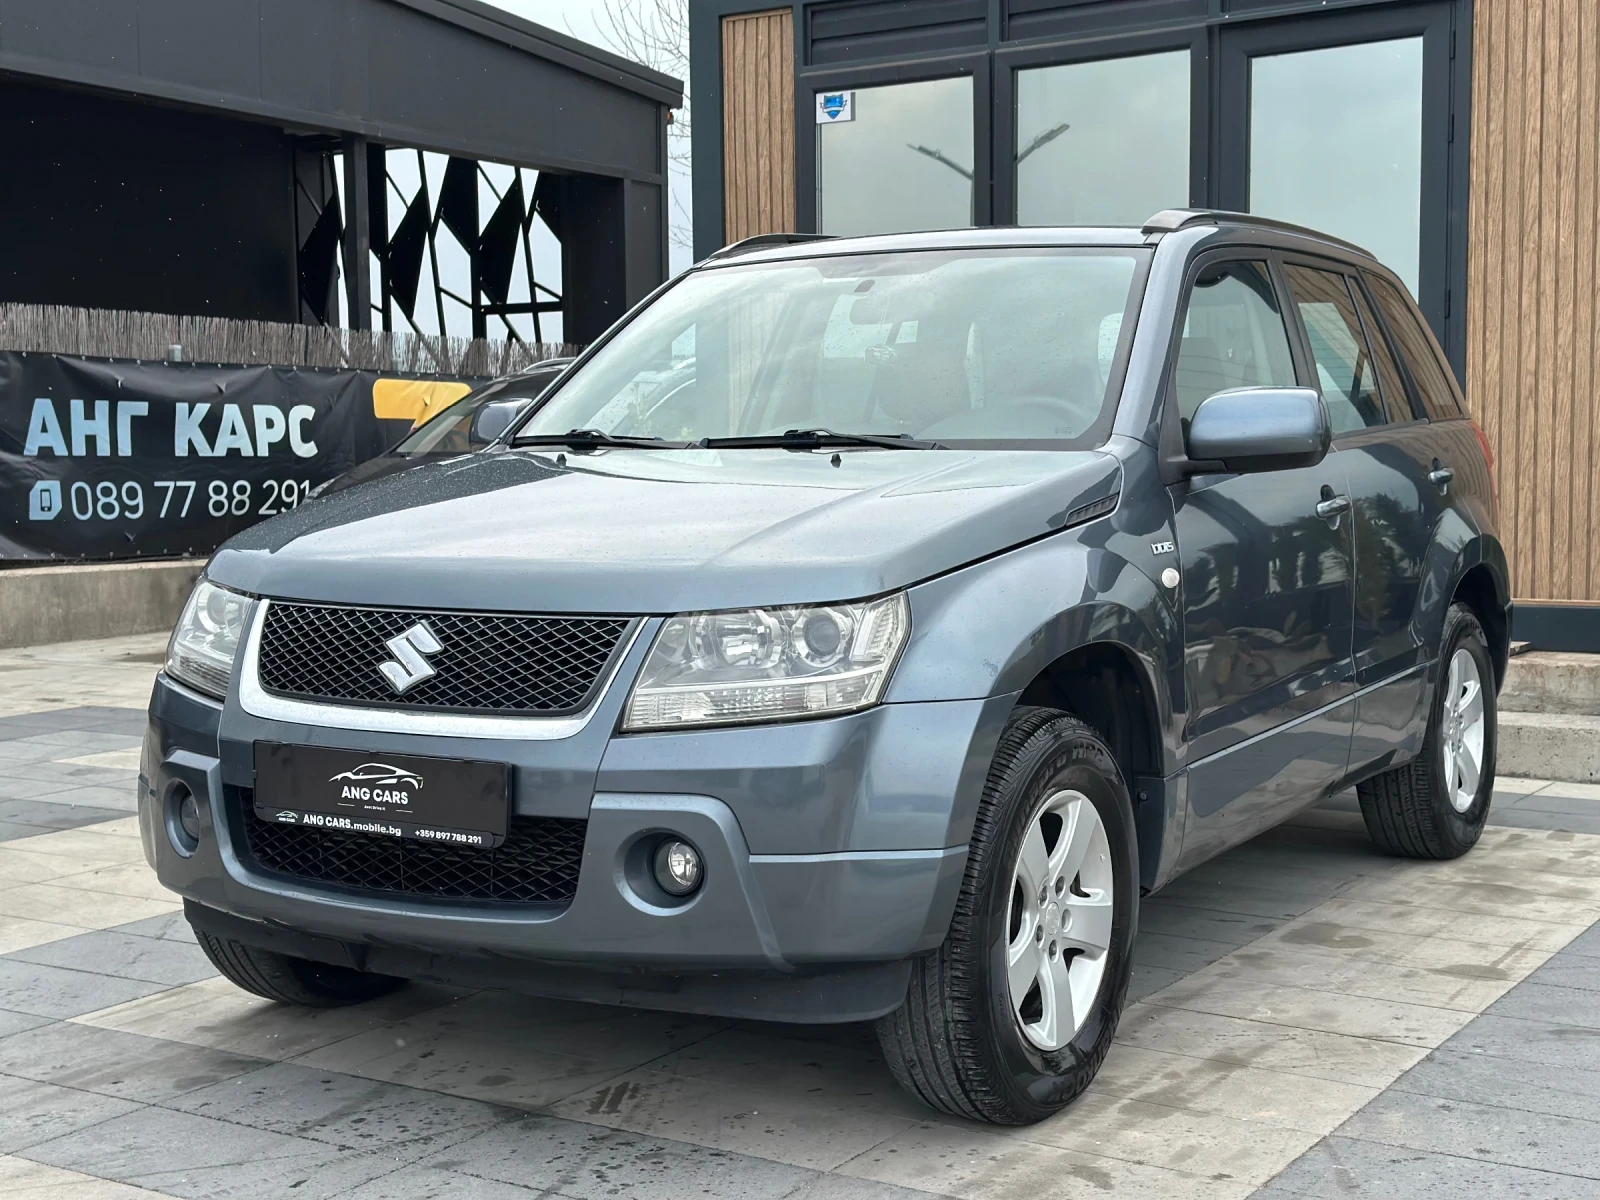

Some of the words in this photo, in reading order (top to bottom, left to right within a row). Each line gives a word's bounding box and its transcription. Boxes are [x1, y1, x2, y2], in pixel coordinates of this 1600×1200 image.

[24, 398, 149, 457] АНГ
[174, 402, 319, 458] КАРС
[71, 481, 143, 520] 089
[154, 481, 196, 518] 77
[208, 479, 251, 517] 88
[341, 785, 371, 801] ANG
[372, 788, 409, 805] CARS
[303, 813, 324, 826] ANG
[325, 816, 402, 837] CARS.mobile.bg
[415, 829, 435, 838] +359
[436, 831, 451, 840] 897
[451, 833, 467, 842] 788
[467, 835, 482, 844] 291
